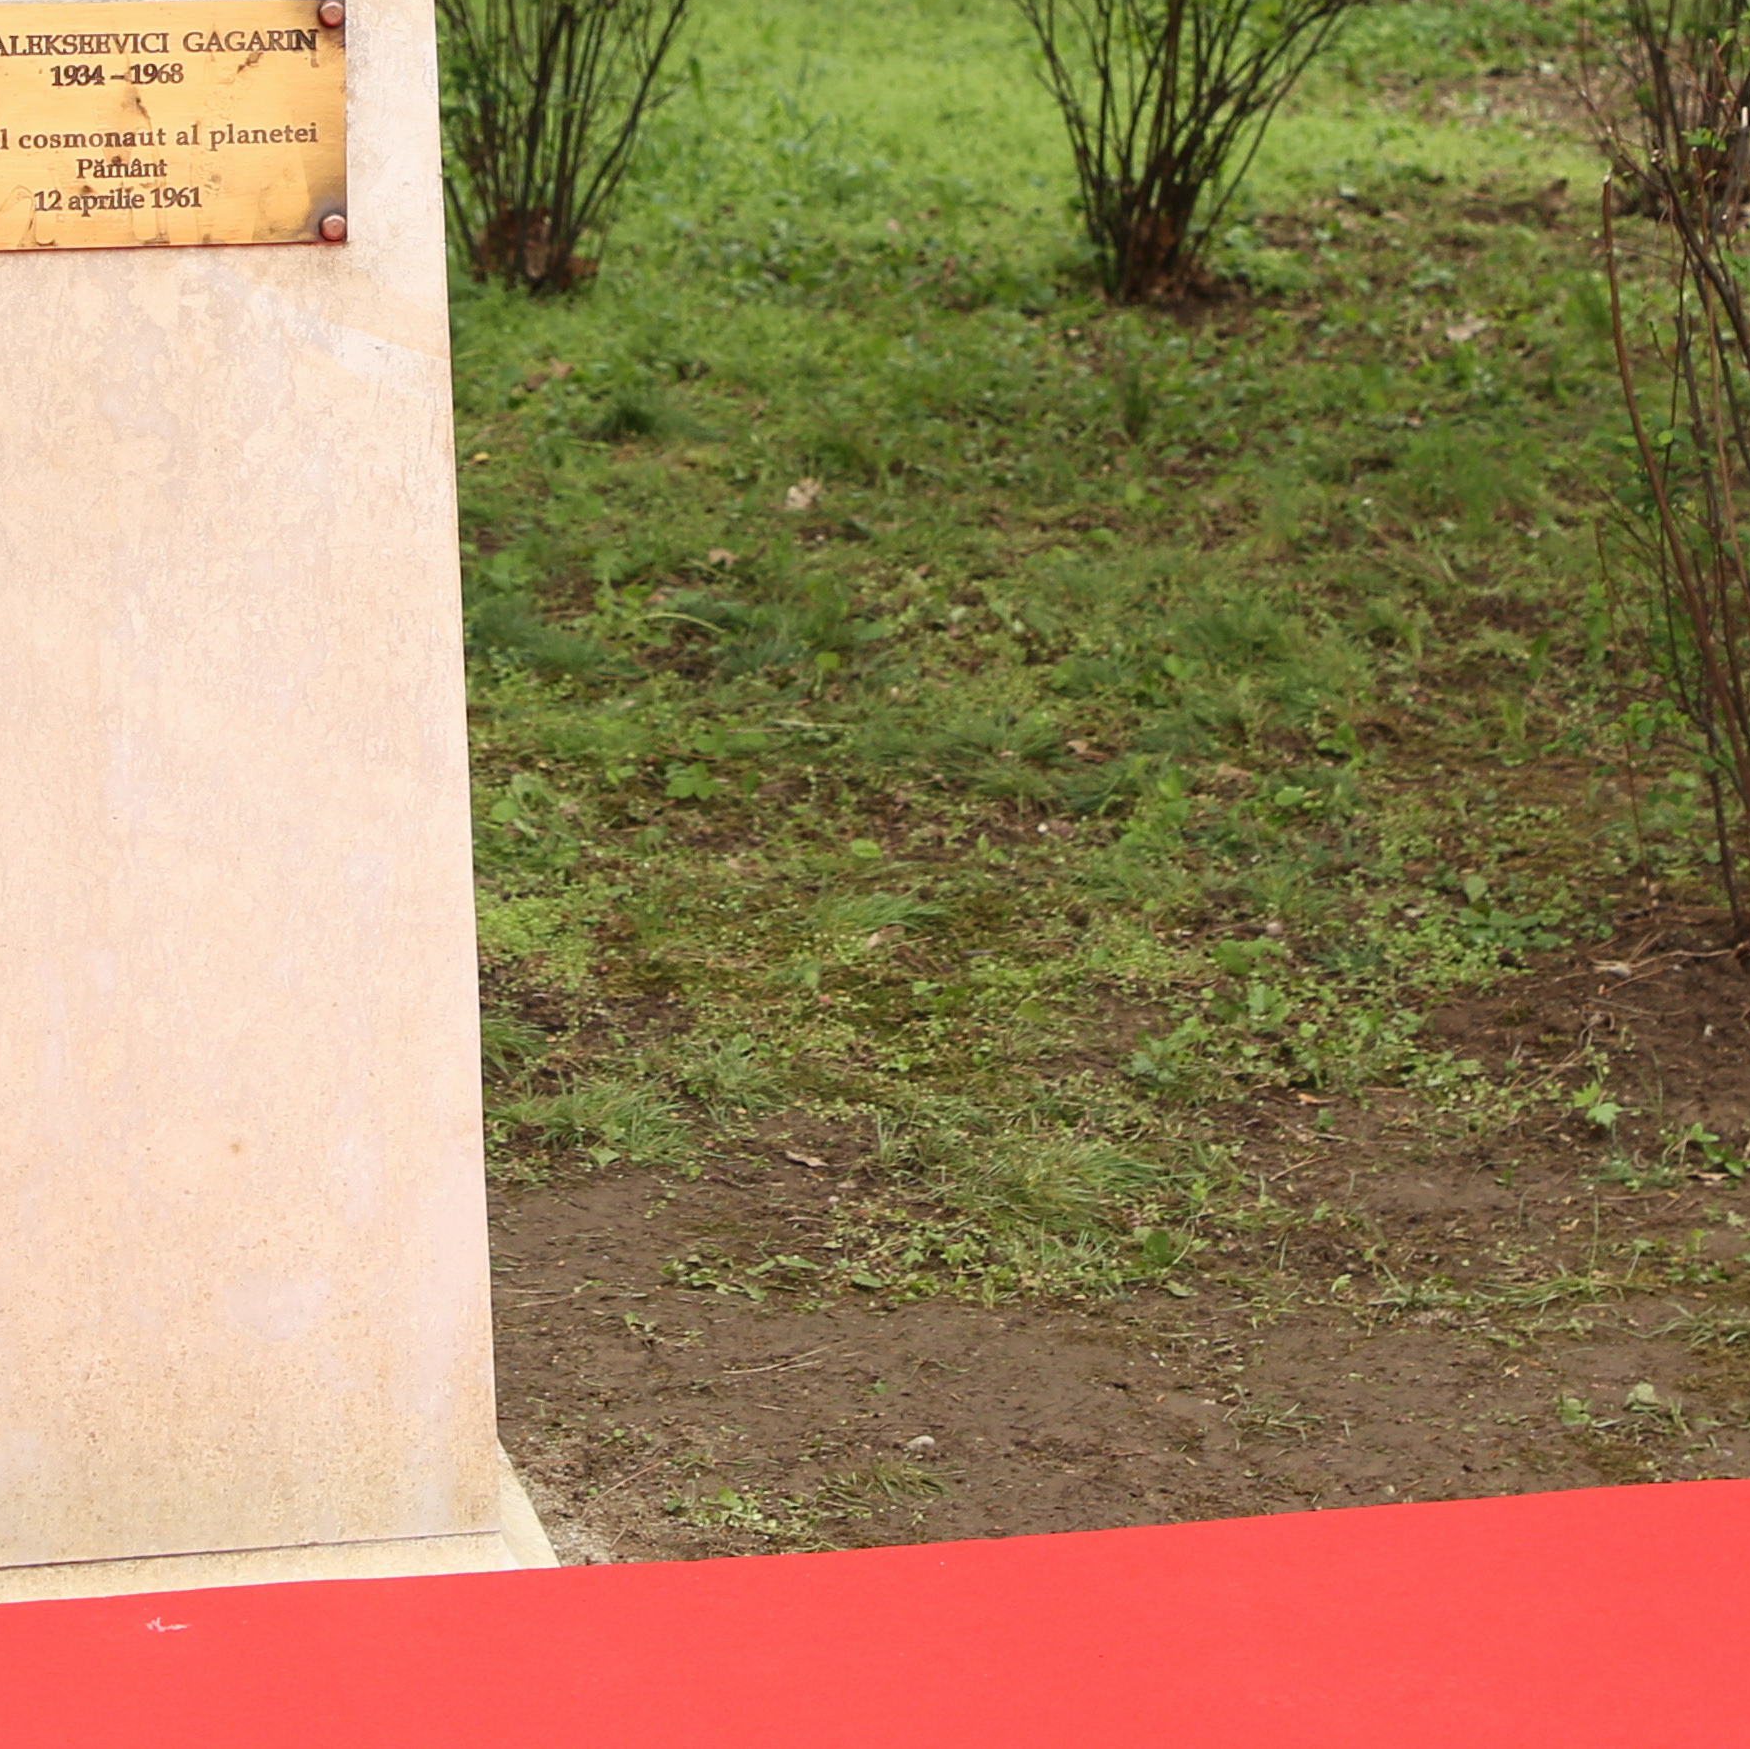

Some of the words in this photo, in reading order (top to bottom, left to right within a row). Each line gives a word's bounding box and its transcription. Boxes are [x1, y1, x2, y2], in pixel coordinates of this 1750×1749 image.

[182, 29, 318, 53] GAGARIN
[50, 64, 105, 87] 1934
[130, 63, 185, 84] 1968
[18, 127, 167, 149] cosmonaut
[176, 124, 200, 147] al
[209, 123, 319, 152] planetei
[76, 157, 168, 179] Pământ
[33, 190, 63, 212] 12
[68, 187, 146, 218] aprilie
[150, 186, 203, 209] 1961
